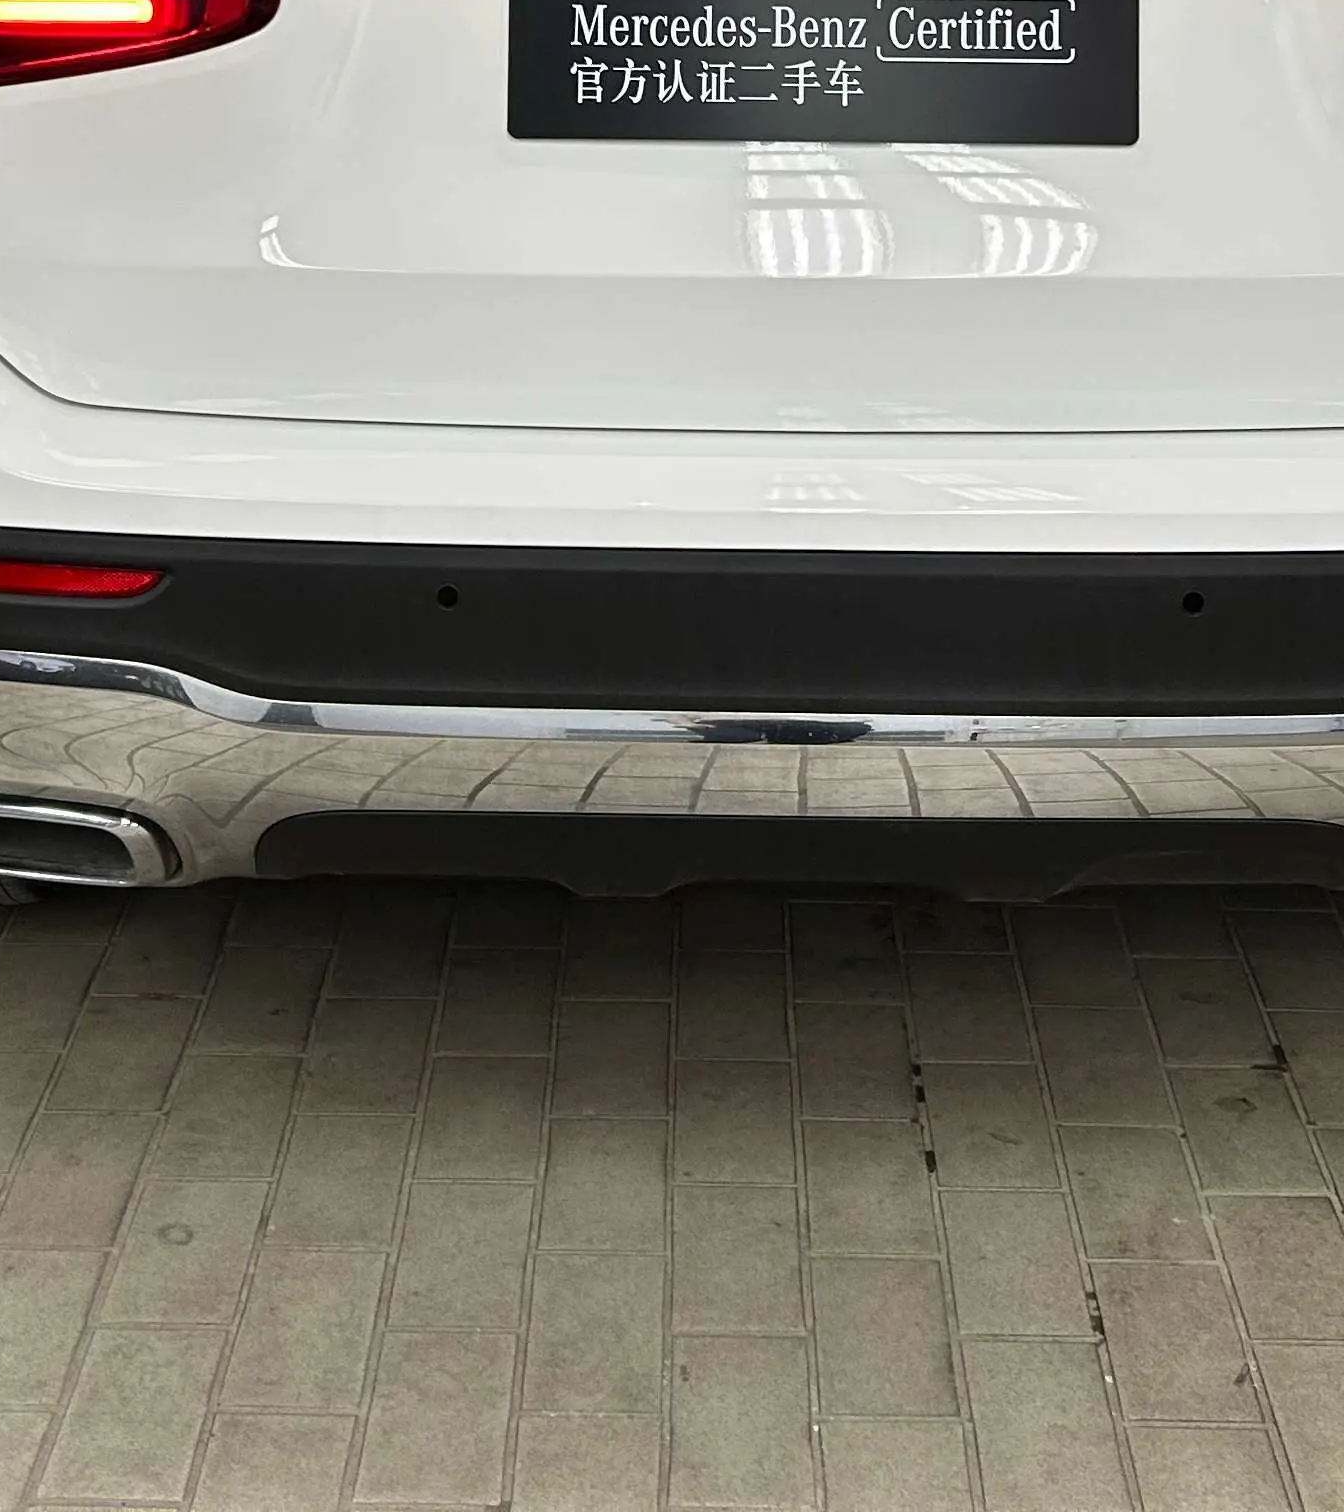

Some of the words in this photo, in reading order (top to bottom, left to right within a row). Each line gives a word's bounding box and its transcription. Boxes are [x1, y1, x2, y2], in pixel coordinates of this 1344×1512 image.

[570, 57, 864, 106] 官方认证二手车
